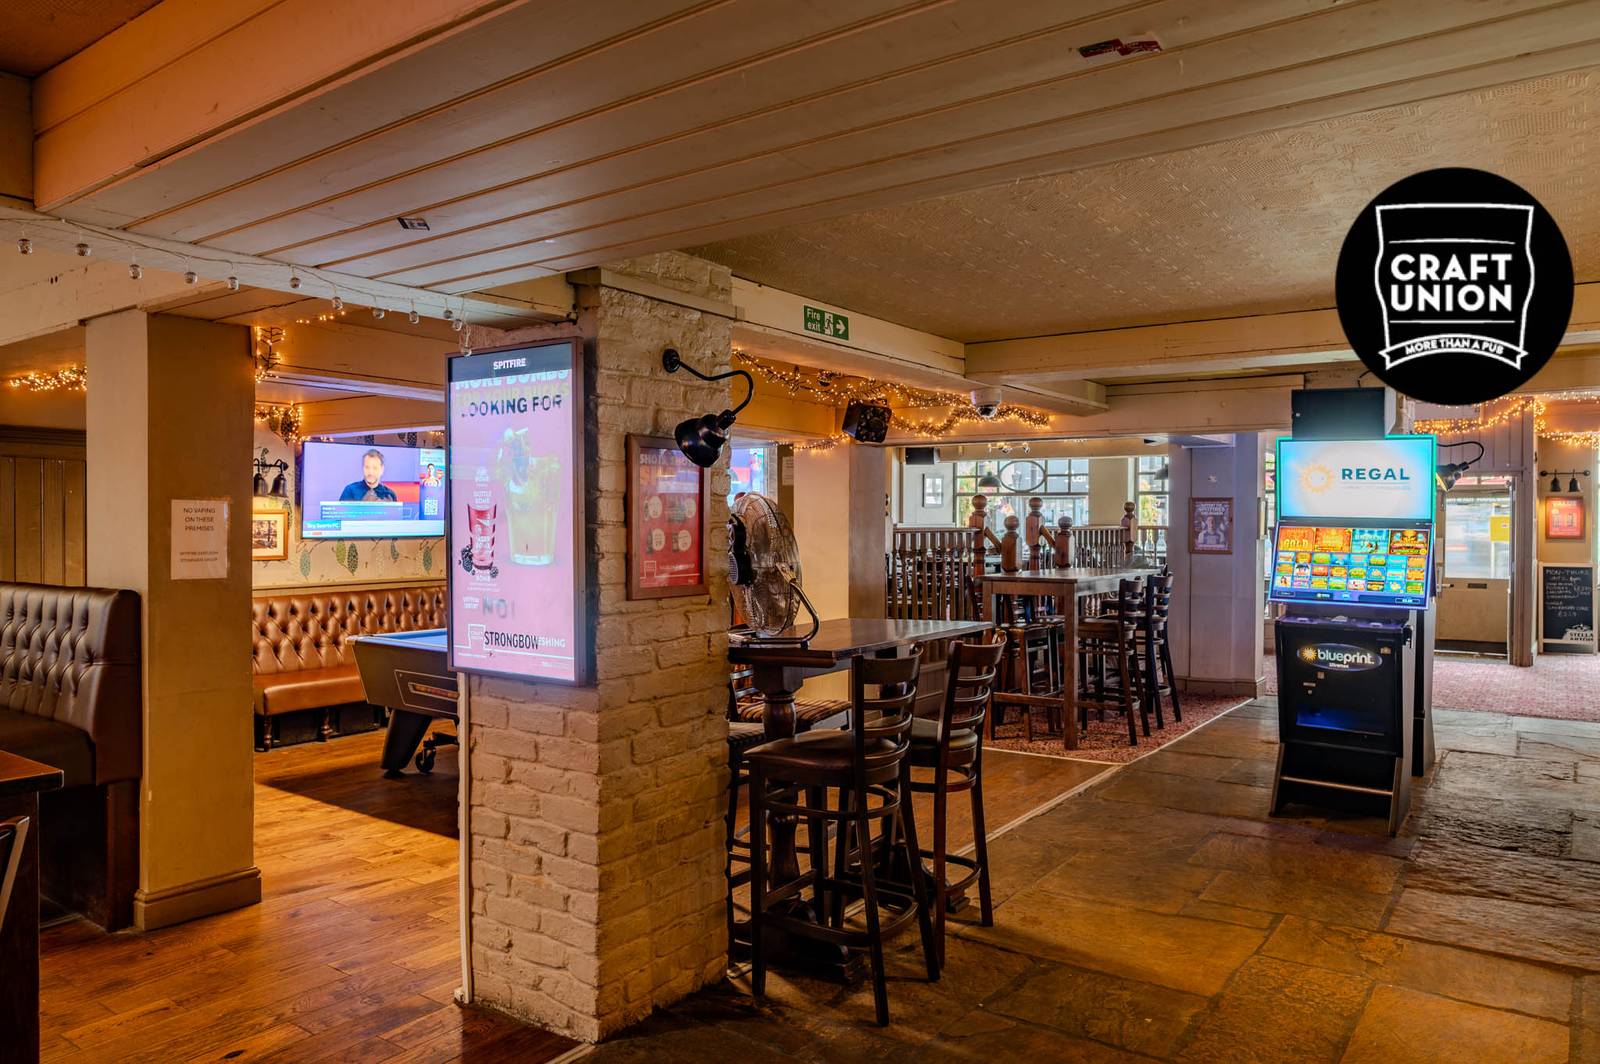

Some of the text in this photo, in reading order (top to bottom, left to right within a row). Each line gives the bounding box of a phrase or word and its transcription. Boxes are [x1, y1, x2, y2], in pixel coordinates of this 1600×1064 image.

[807, 308, 820, 321] Fire
[807, 321, 820, 332] exit
[493, 358, 527, 370] SPITFIRE
[532, 394, 562, 412] FOR
[1341, 467, 1410, 480] REGAL
[484, 631, 539, 650] STRONGBOW
